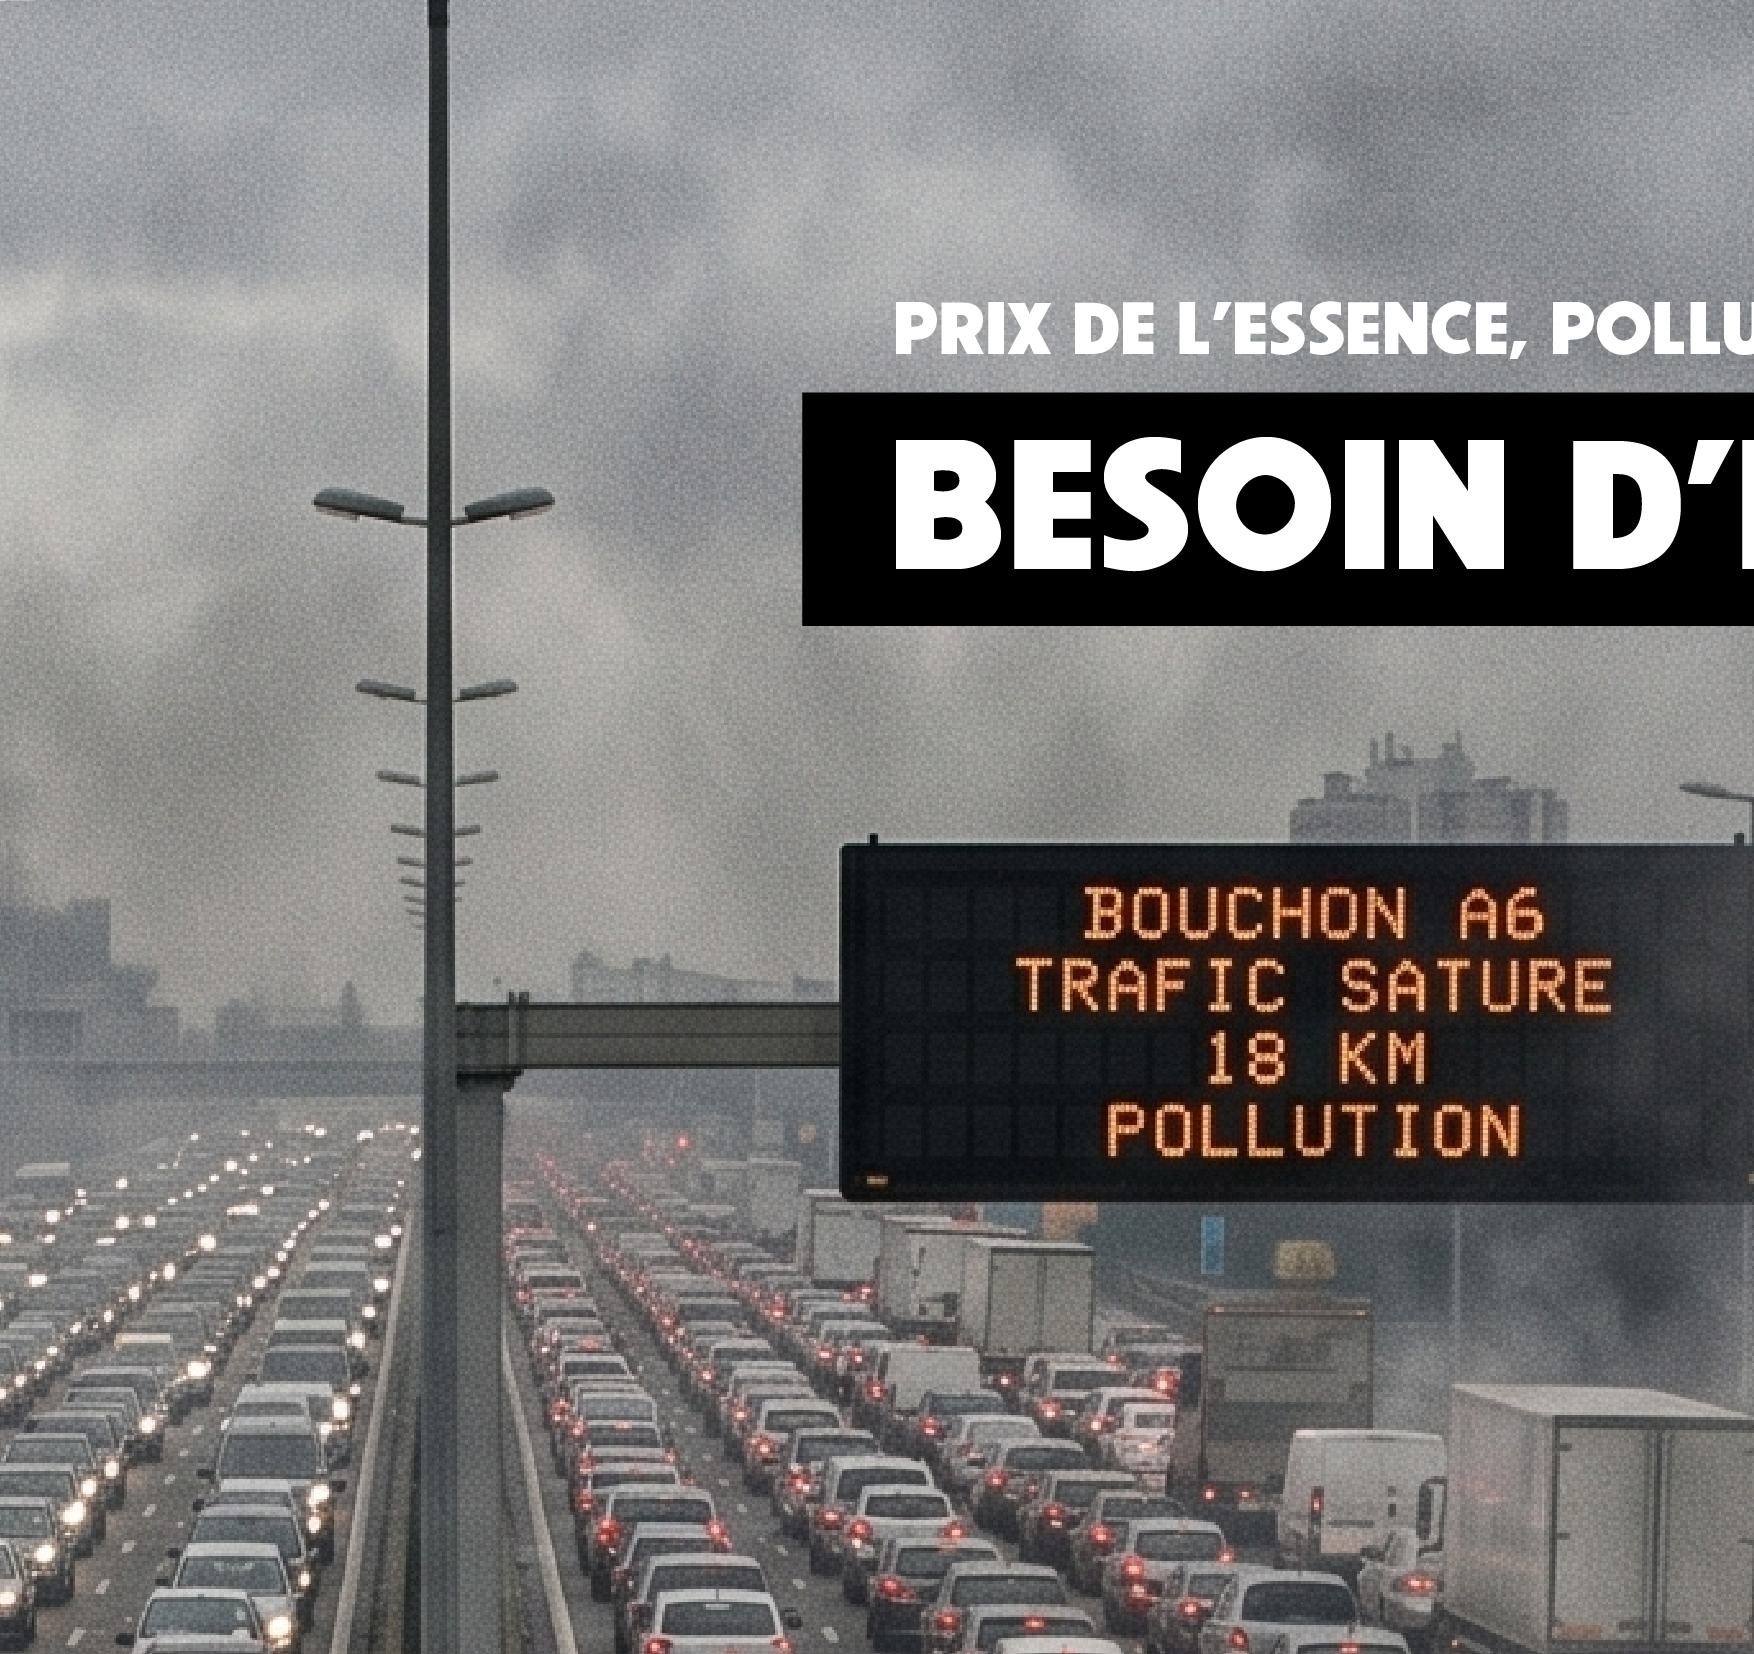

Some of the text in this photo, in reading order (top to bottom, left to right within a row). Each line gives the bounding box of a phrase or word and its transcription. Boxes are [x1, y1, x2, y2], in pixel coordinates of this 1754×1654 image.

[1083, 885, 1546, 941] BOUCHON A6
[1015, 957, 1613, 1013] TRAFIC SATURE
[1209, 1032, 1427, 1086] 18 KM
[1106, 1103, 1521, 1157] POLLUTION
